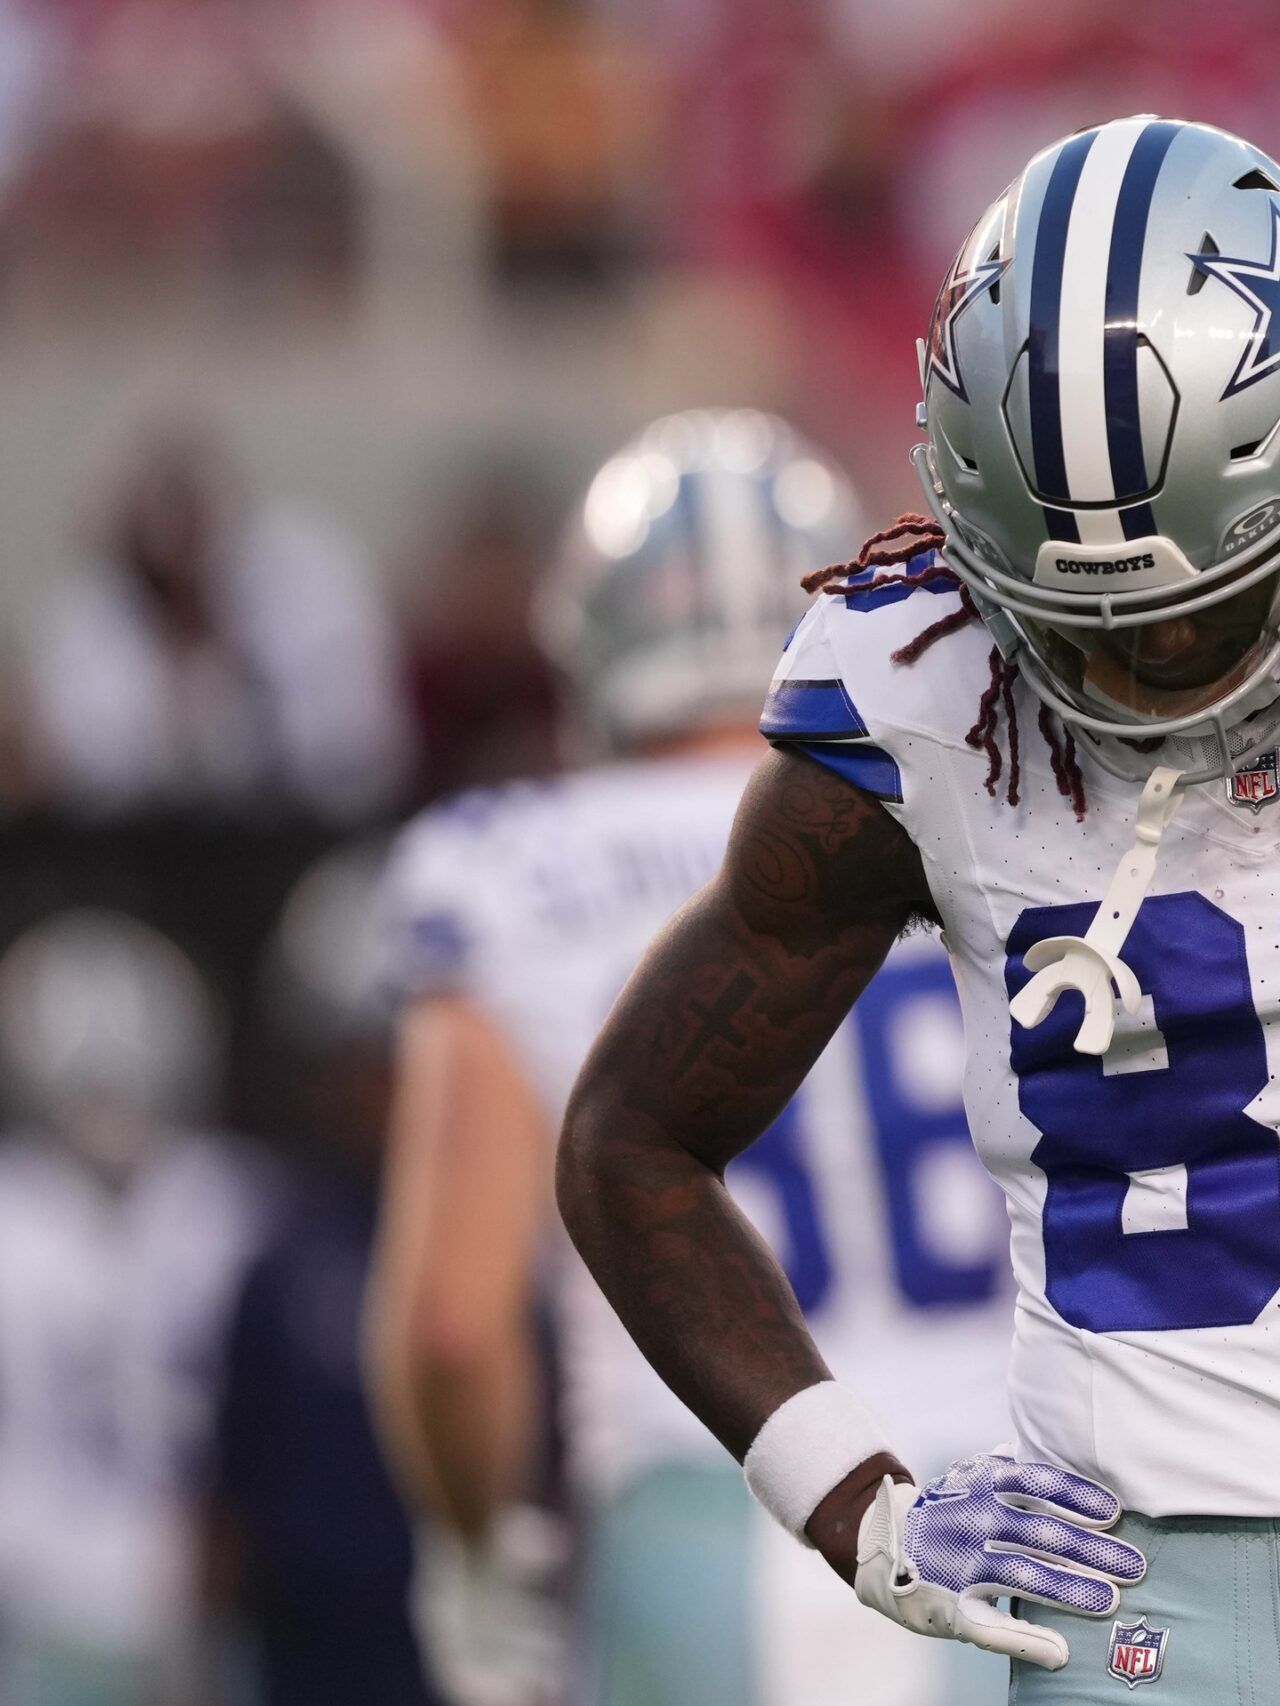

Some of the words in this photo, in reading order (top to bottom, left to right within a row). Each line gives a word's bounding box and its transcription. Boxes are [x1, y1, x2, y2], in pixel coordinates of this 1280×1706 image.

[1055, 553, 1155, 575] COWBOYS
[1234, 771, 1277, 800] NFL
[1114, 1645, 1154, 1677] NFL
